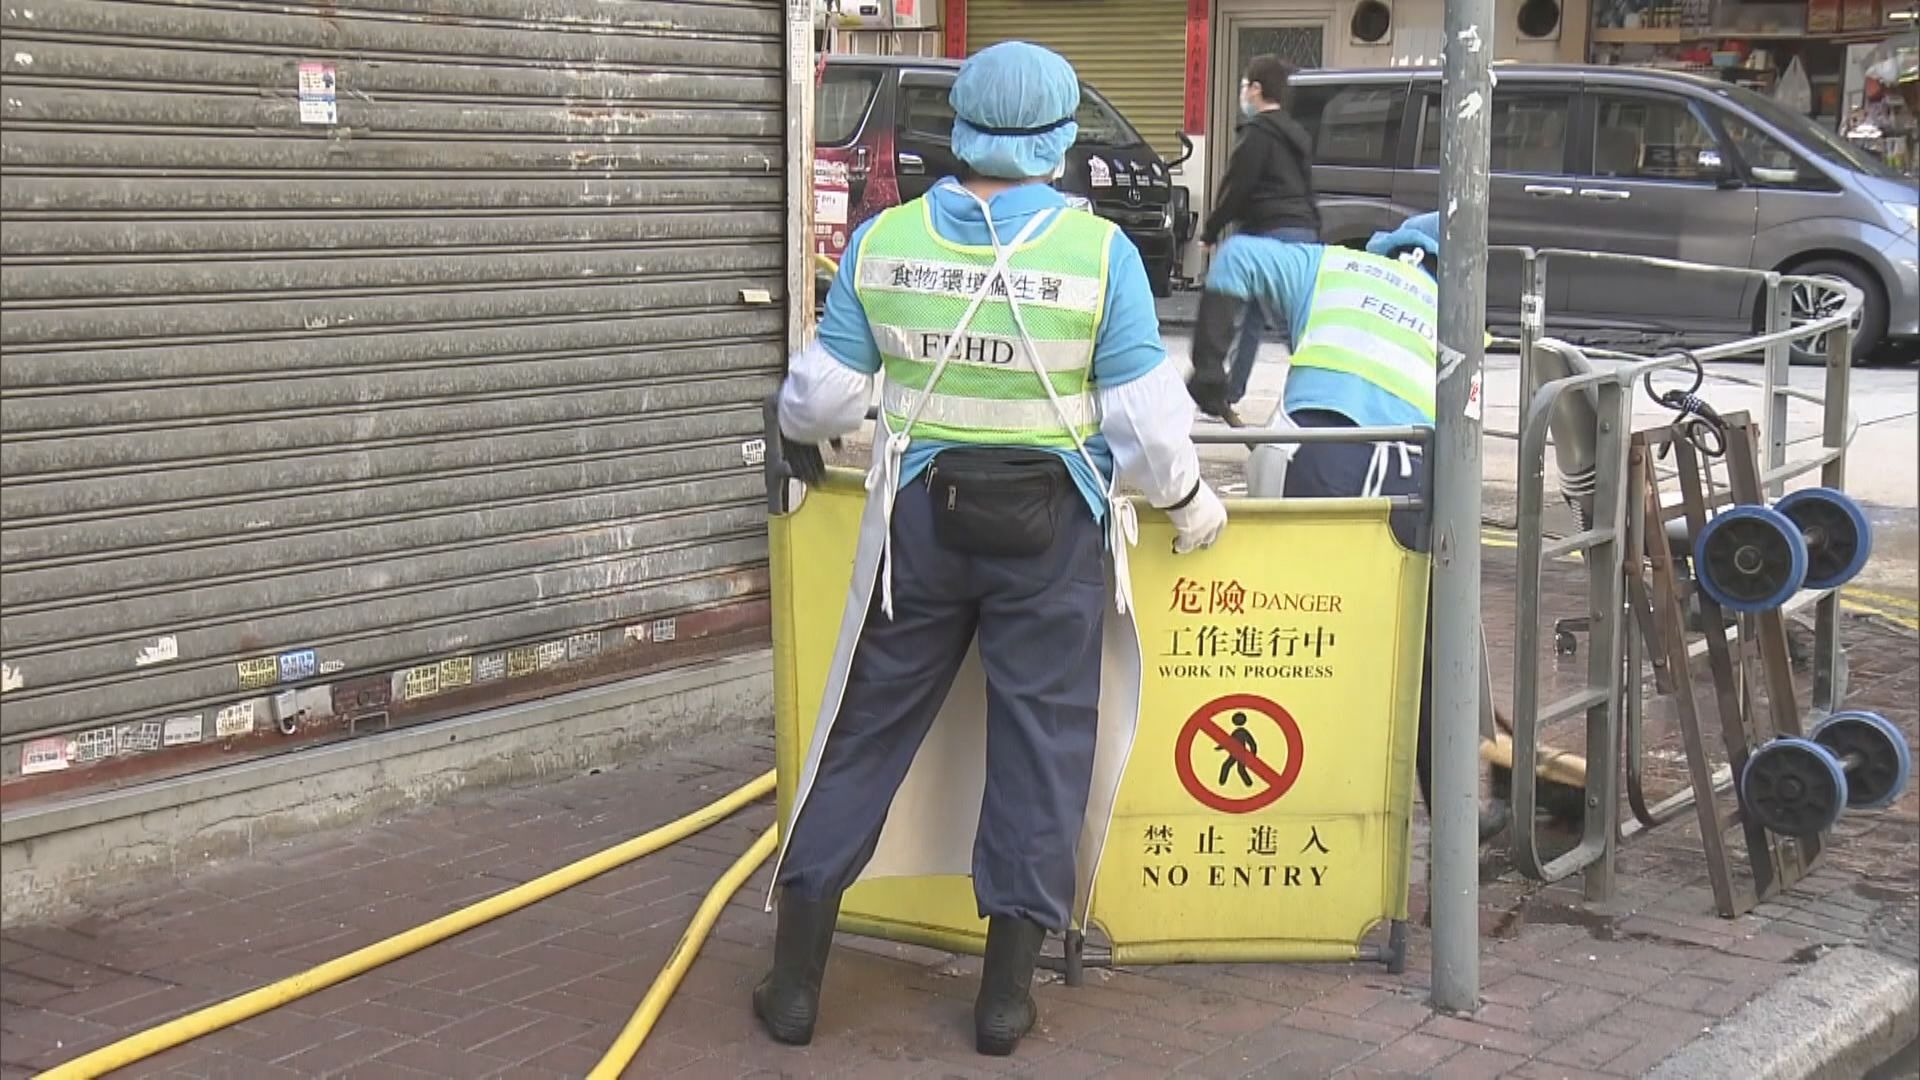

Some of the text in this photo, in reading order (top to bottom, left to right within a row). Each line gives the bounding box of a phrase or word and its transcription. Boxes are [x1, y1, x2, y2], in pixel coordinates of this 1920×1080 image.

[1360, 295, 1434, 340] FEHD
[1169, 577, 1342, 615] 危險 DANGER
[1159, 626, 1335, 658] 工作進行中
[1159, 665, 1333, 678] WORK IN PROGRESS
[1143, 824, 1331, 856] 禁止進入
[1143, 865, 1328, 887] NO ENTRY
